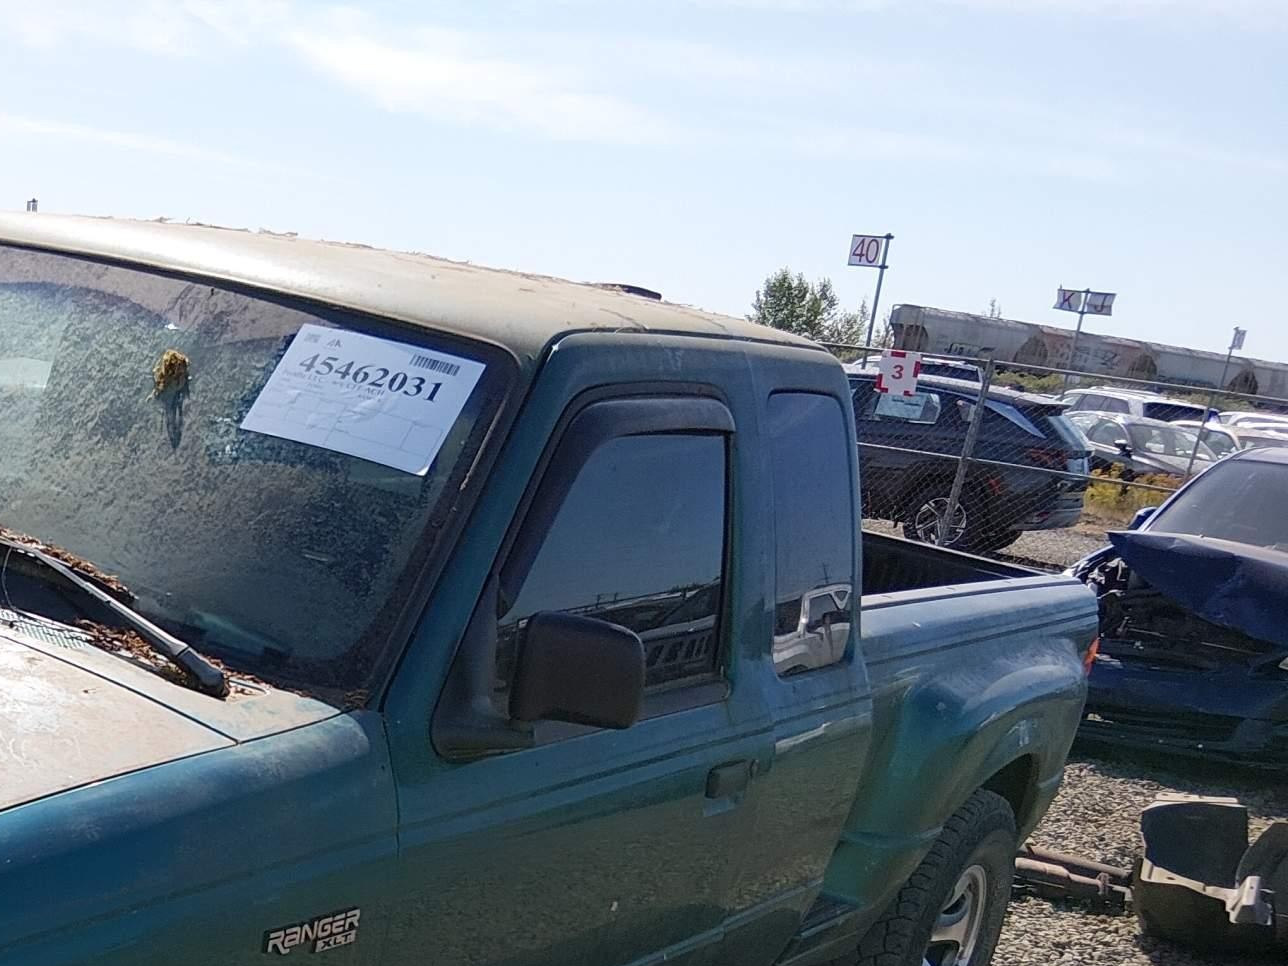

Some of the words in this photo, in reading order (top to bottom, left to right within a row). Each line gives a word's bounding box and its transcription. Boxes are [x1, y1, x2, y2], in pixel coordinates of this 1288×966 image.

[851, 237, 880, 264] 40
[1059, 291, 1076, 309] K
[1094, 293, 1109, 313] J
[299, 353, 444, 402] 45462031
[891, 364, 905, 380] 3
[267, 908, 361, 955] RANGER
[319, 932, 354, 951] XLT
